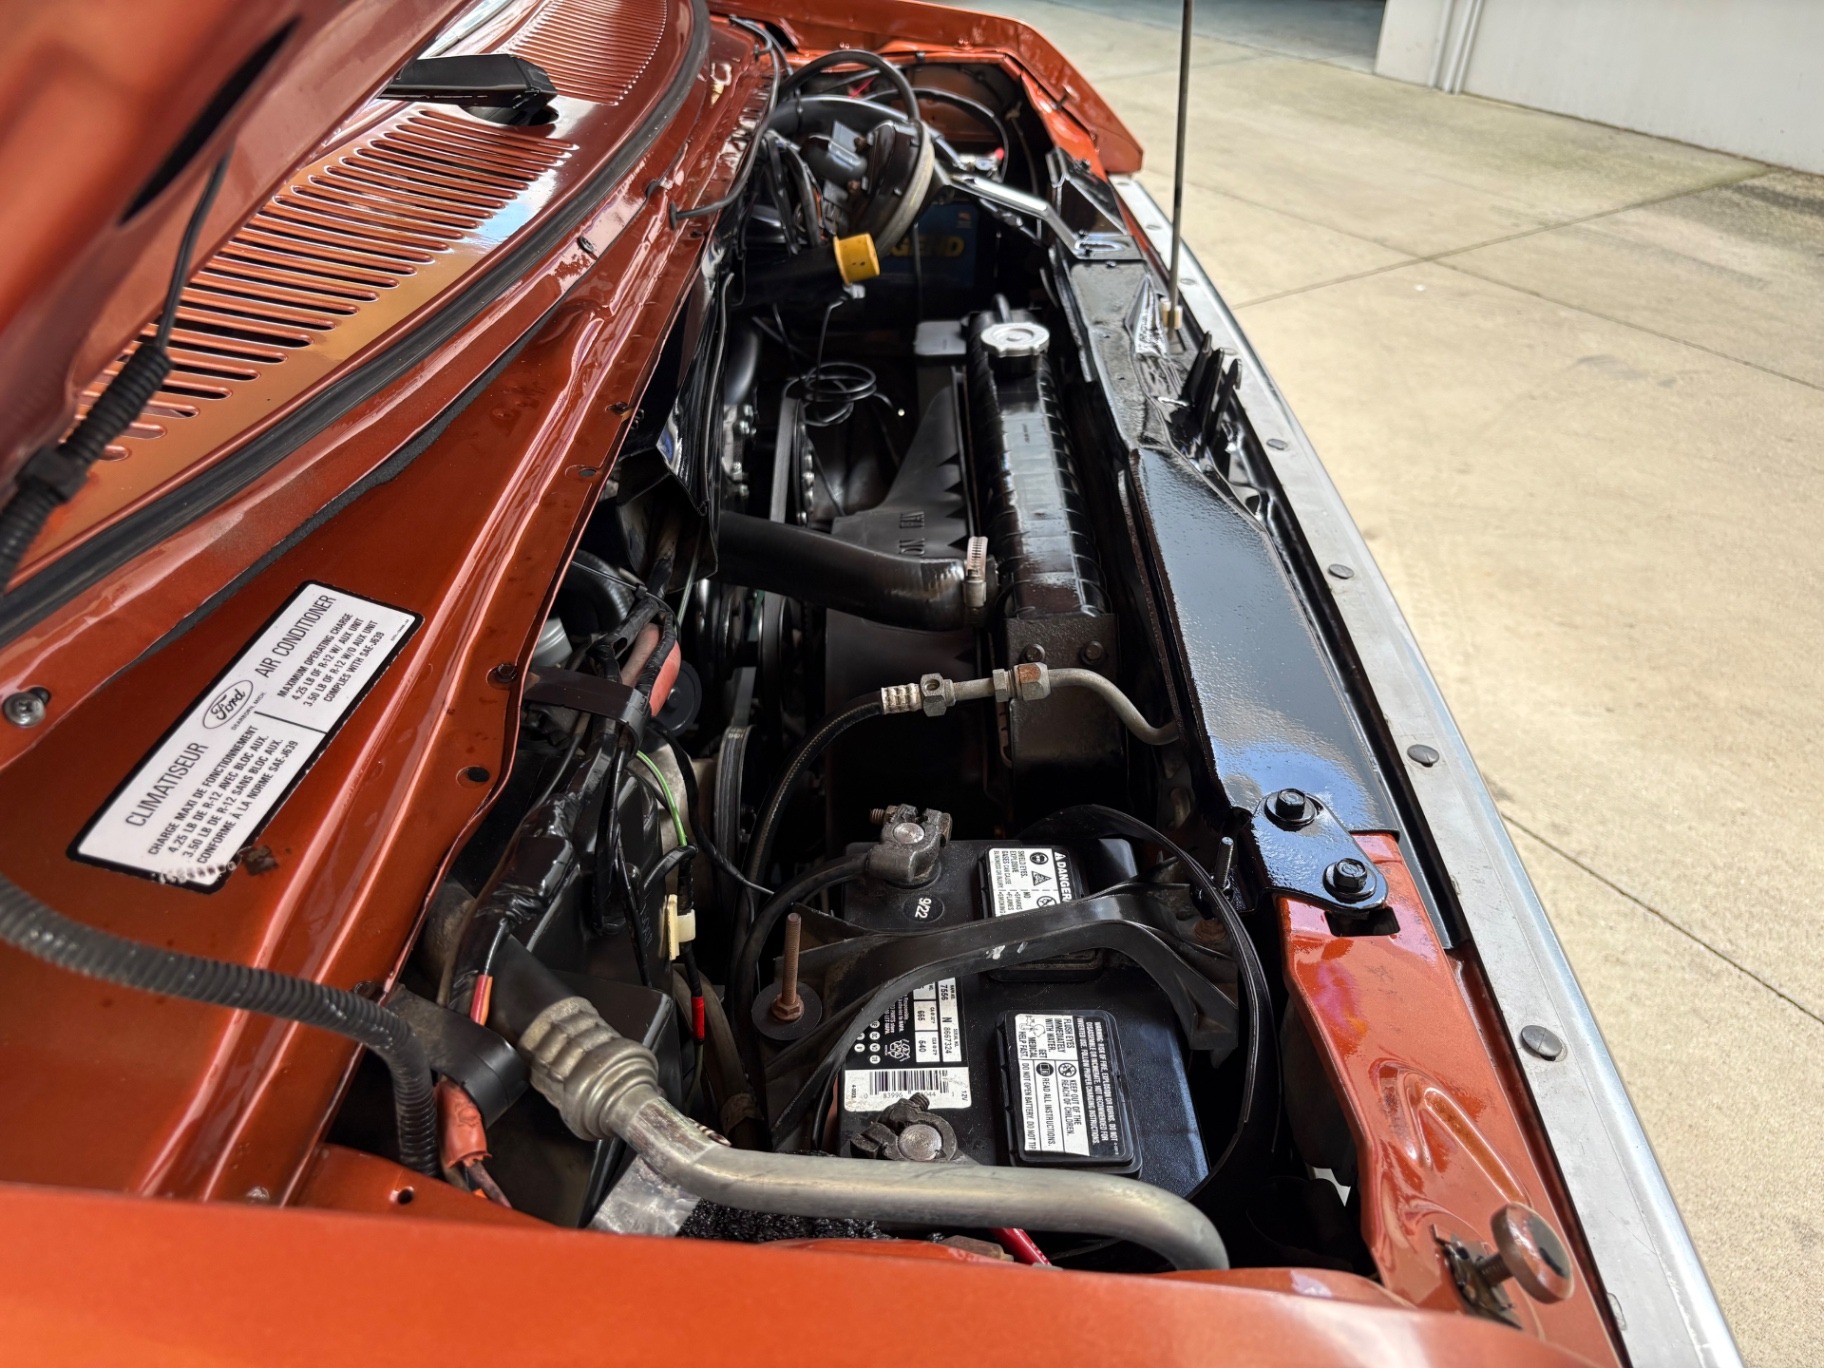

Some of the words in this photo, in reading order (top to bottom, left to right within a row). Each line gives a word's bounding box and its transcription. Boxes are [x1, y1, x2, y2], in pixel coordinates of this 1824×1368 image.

[255, 657, 281, 678] AIR
[272, 595, 335, 656] CONDITIONER
[277, 666, 307, 697] MAXIMUM
[304, 635, 334, 665] OPERATING
[330, 613, 352, 635] CHARGE
[292, 686, 308, 700] 4.25
[303, 677, 315, 686] LB
[310, 668, 322, 677] OF
[318, 654, 334, 668] R-12
[329, 645, 342, 654] W/
[338, 632, 353, 644] AUX
[348, 618, 363, 631] UNIT
[303, 692, 320, 707] 3.50
[315, 683, 327, 692] LB
[322, 674, 333, 683] OF
[329, 660, 346, 674] R-12
[341, 647, 356, 660] W/O
[353, 634, 367, 647] AUX
[362, 620, 377, 634] UNIT
[324, 673, 351, 702] COMPLIES
[346, 657, 364, 672] WITH
[359, 632, 384, 657] SAE-J639
[210, 688, 245, 720] Ford
[126, 743, 207, 826] CLIMATISEUR
[148, 823, 179, 855] CHARGE
[174, 800, 197, 821] MAXI
[192, 788, 207, 799] DE
[202, 726, 257, 786] FONCTIONNEMENT
[168, 835, 188, 853] 4.25
[183, 822, 197, 833] LB
[192, 810, 207, 821] DE
[202, 791, 223, 809] R-12
[219, 772, 238, 790] AVEC
[233, 752, 254, 771] BLOC
[250, 735, 269, 752] AUX.
[182, 839, 203, 858] 3.50
[198, 827, 212, 837] LB
[207, 815, 222, 826] DE
[216, 796, 237, 814] R-12
[232, 775, 253, 795] SANS
[248, 756, 268, 774] BLOC
[264, 739, 284, 755] AUX.
[197, 821, 235, 863] CONFORME
[237, 801, 252, 811] LA
[247, 773, 273, 799] NORME
[269, 741, 298, 772] SAE-J639
[1018, 851, 1026, 865] SHIELD
[1057, 862, 1072, 902] DANGER
[914, 897, 932, 919] 9/22
[1045, 1018, 1054, 1031] WITH
[1064, 1018, 1073, 1034] FLUSH
[1018, 1031, 1027, 1044] HELP
[1047, 1033, 1056, 1052] WATER.
[1055, 1019, 1065, 1053] IMMEDIATELY
[1065, 1035, 1075, 1048] EYES
[1028, 1037, 1037, 1058] MEDICAL
[1038, 1049, 1048, 1058] GET
[1023, 1071, 1031, 1081] NOT
[1042, 1078, 1050, 1092] READ
[1069, 1079, 1078, 1093] KEEP
[1024, 1082, 1032, 1096] OPEN
[1043, 1093, 1052, 1103] ALL
[1061, 1079, 1070, 1097] REACH
[1025, 1097, 1034, 1119] BATTERY.
[1070, 1094, 1080, 1105] OUT
[1026, 1121, 1035, 1129] DO
[1045, 1104, 1055, 1146] INSTRUCTIONS.
[1064, 1107, 1074, 1135] CHILDREN.
[1074, 1115, 1082, 1125] THE
[1027, 1130, 1036, 1141] NOT
